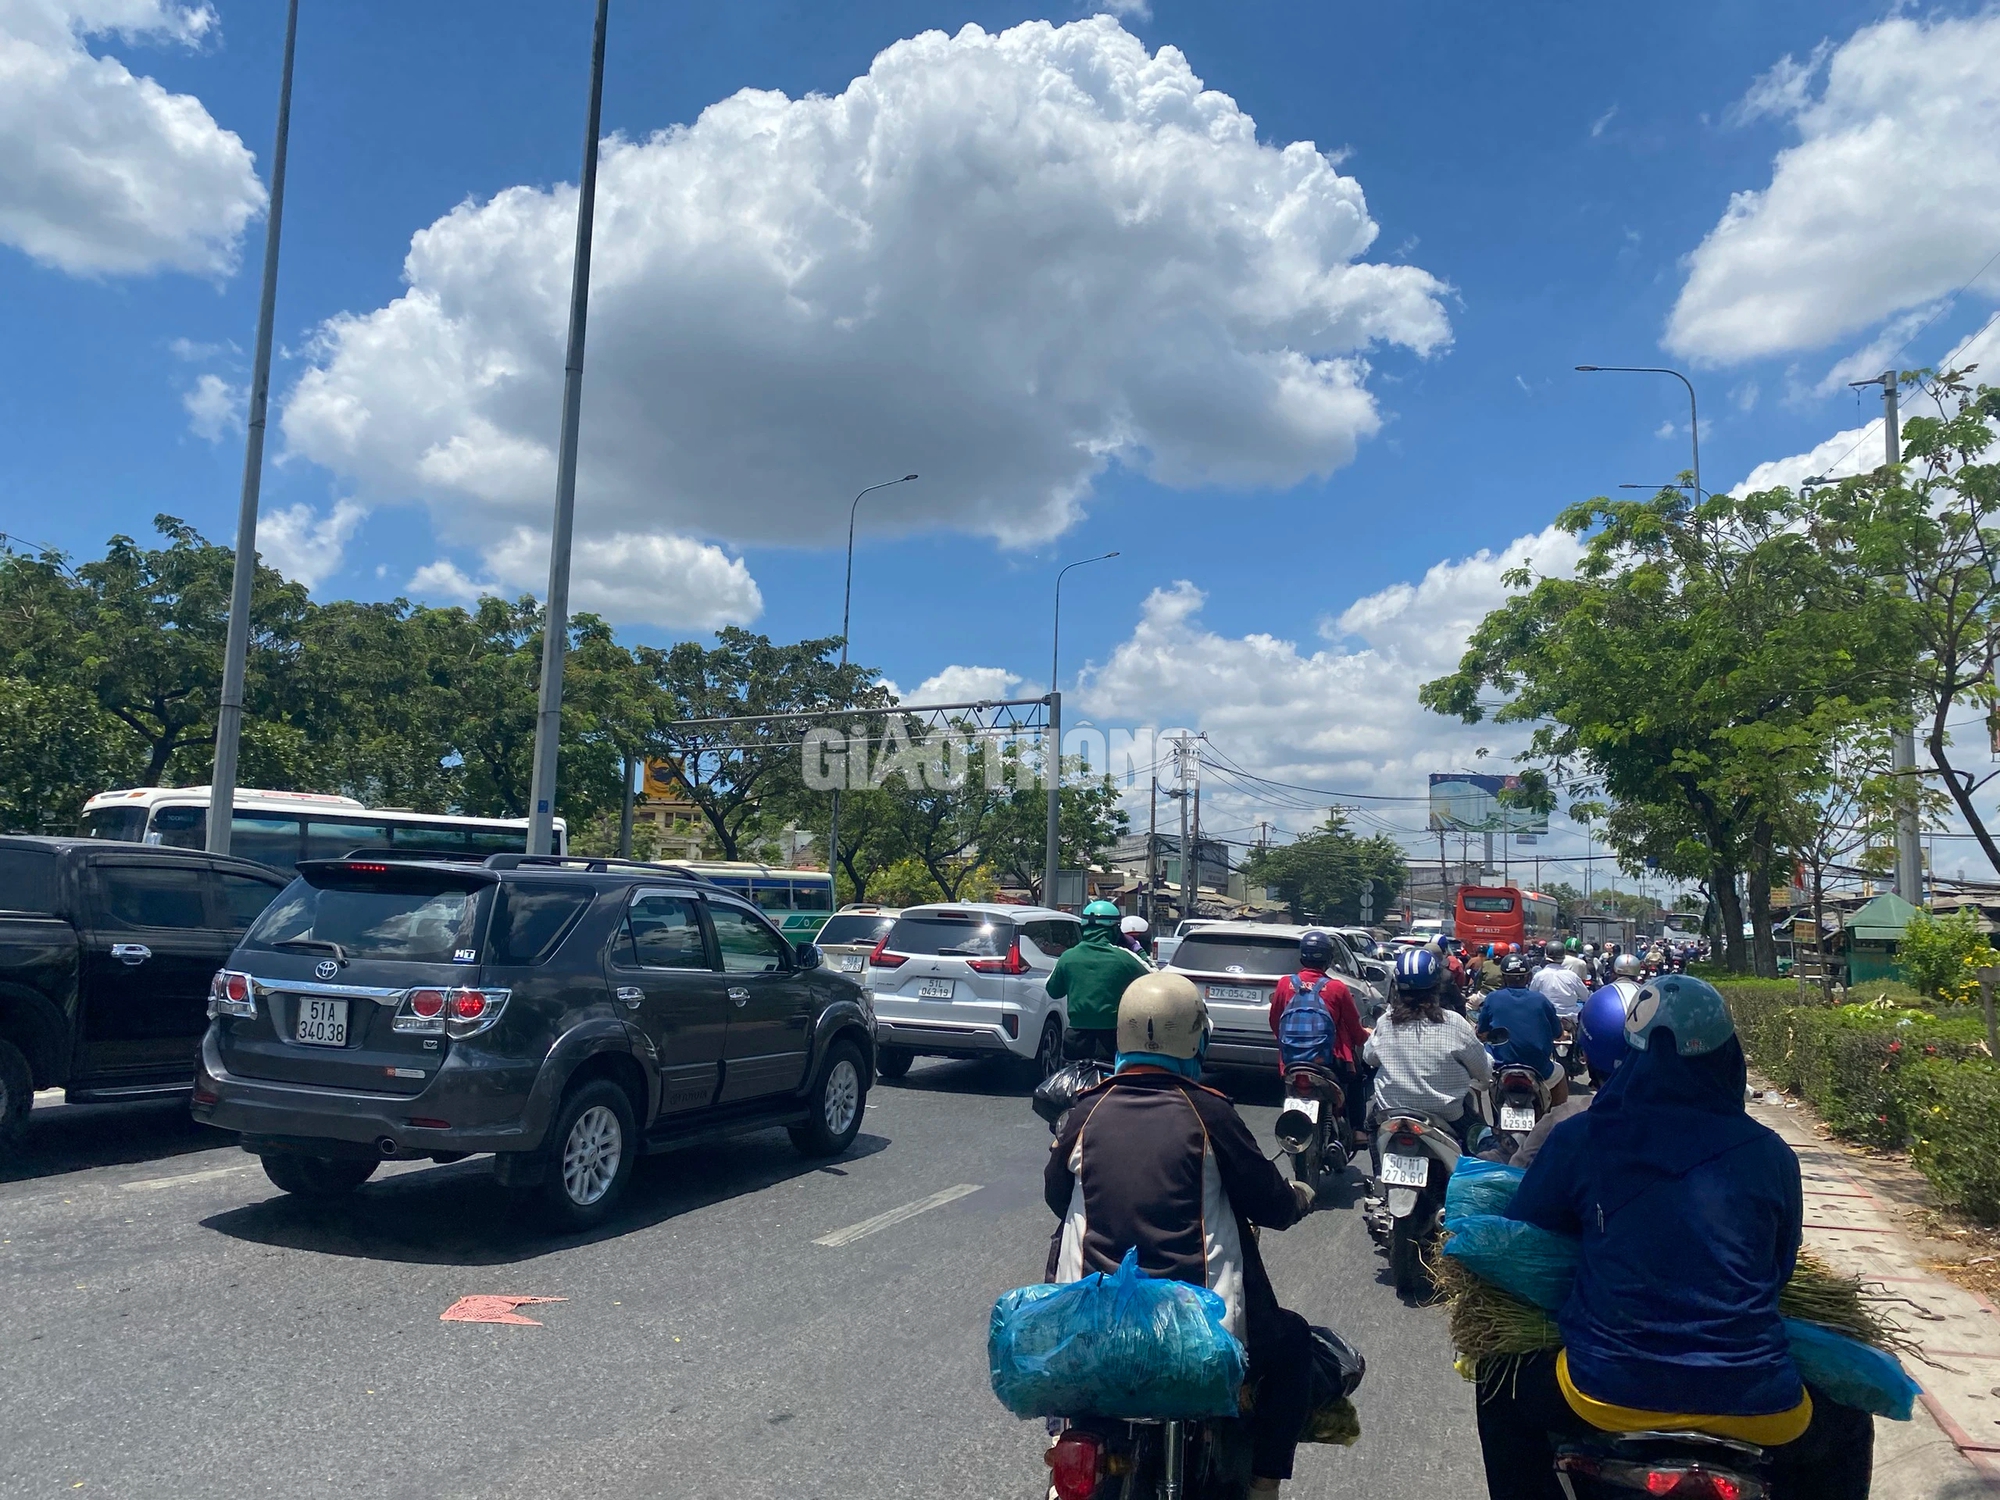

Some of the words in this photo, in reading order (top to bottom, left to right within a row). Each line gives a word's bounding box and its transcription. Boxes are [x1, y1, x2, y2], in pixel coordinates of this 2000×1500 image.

[928, 979, 943, 987] 51L
[310, 1001, 335, 1021] 51A
[299, 1020, 344, 1042] 340.38
[1384, 1169, 1424, 1185] 278.60
